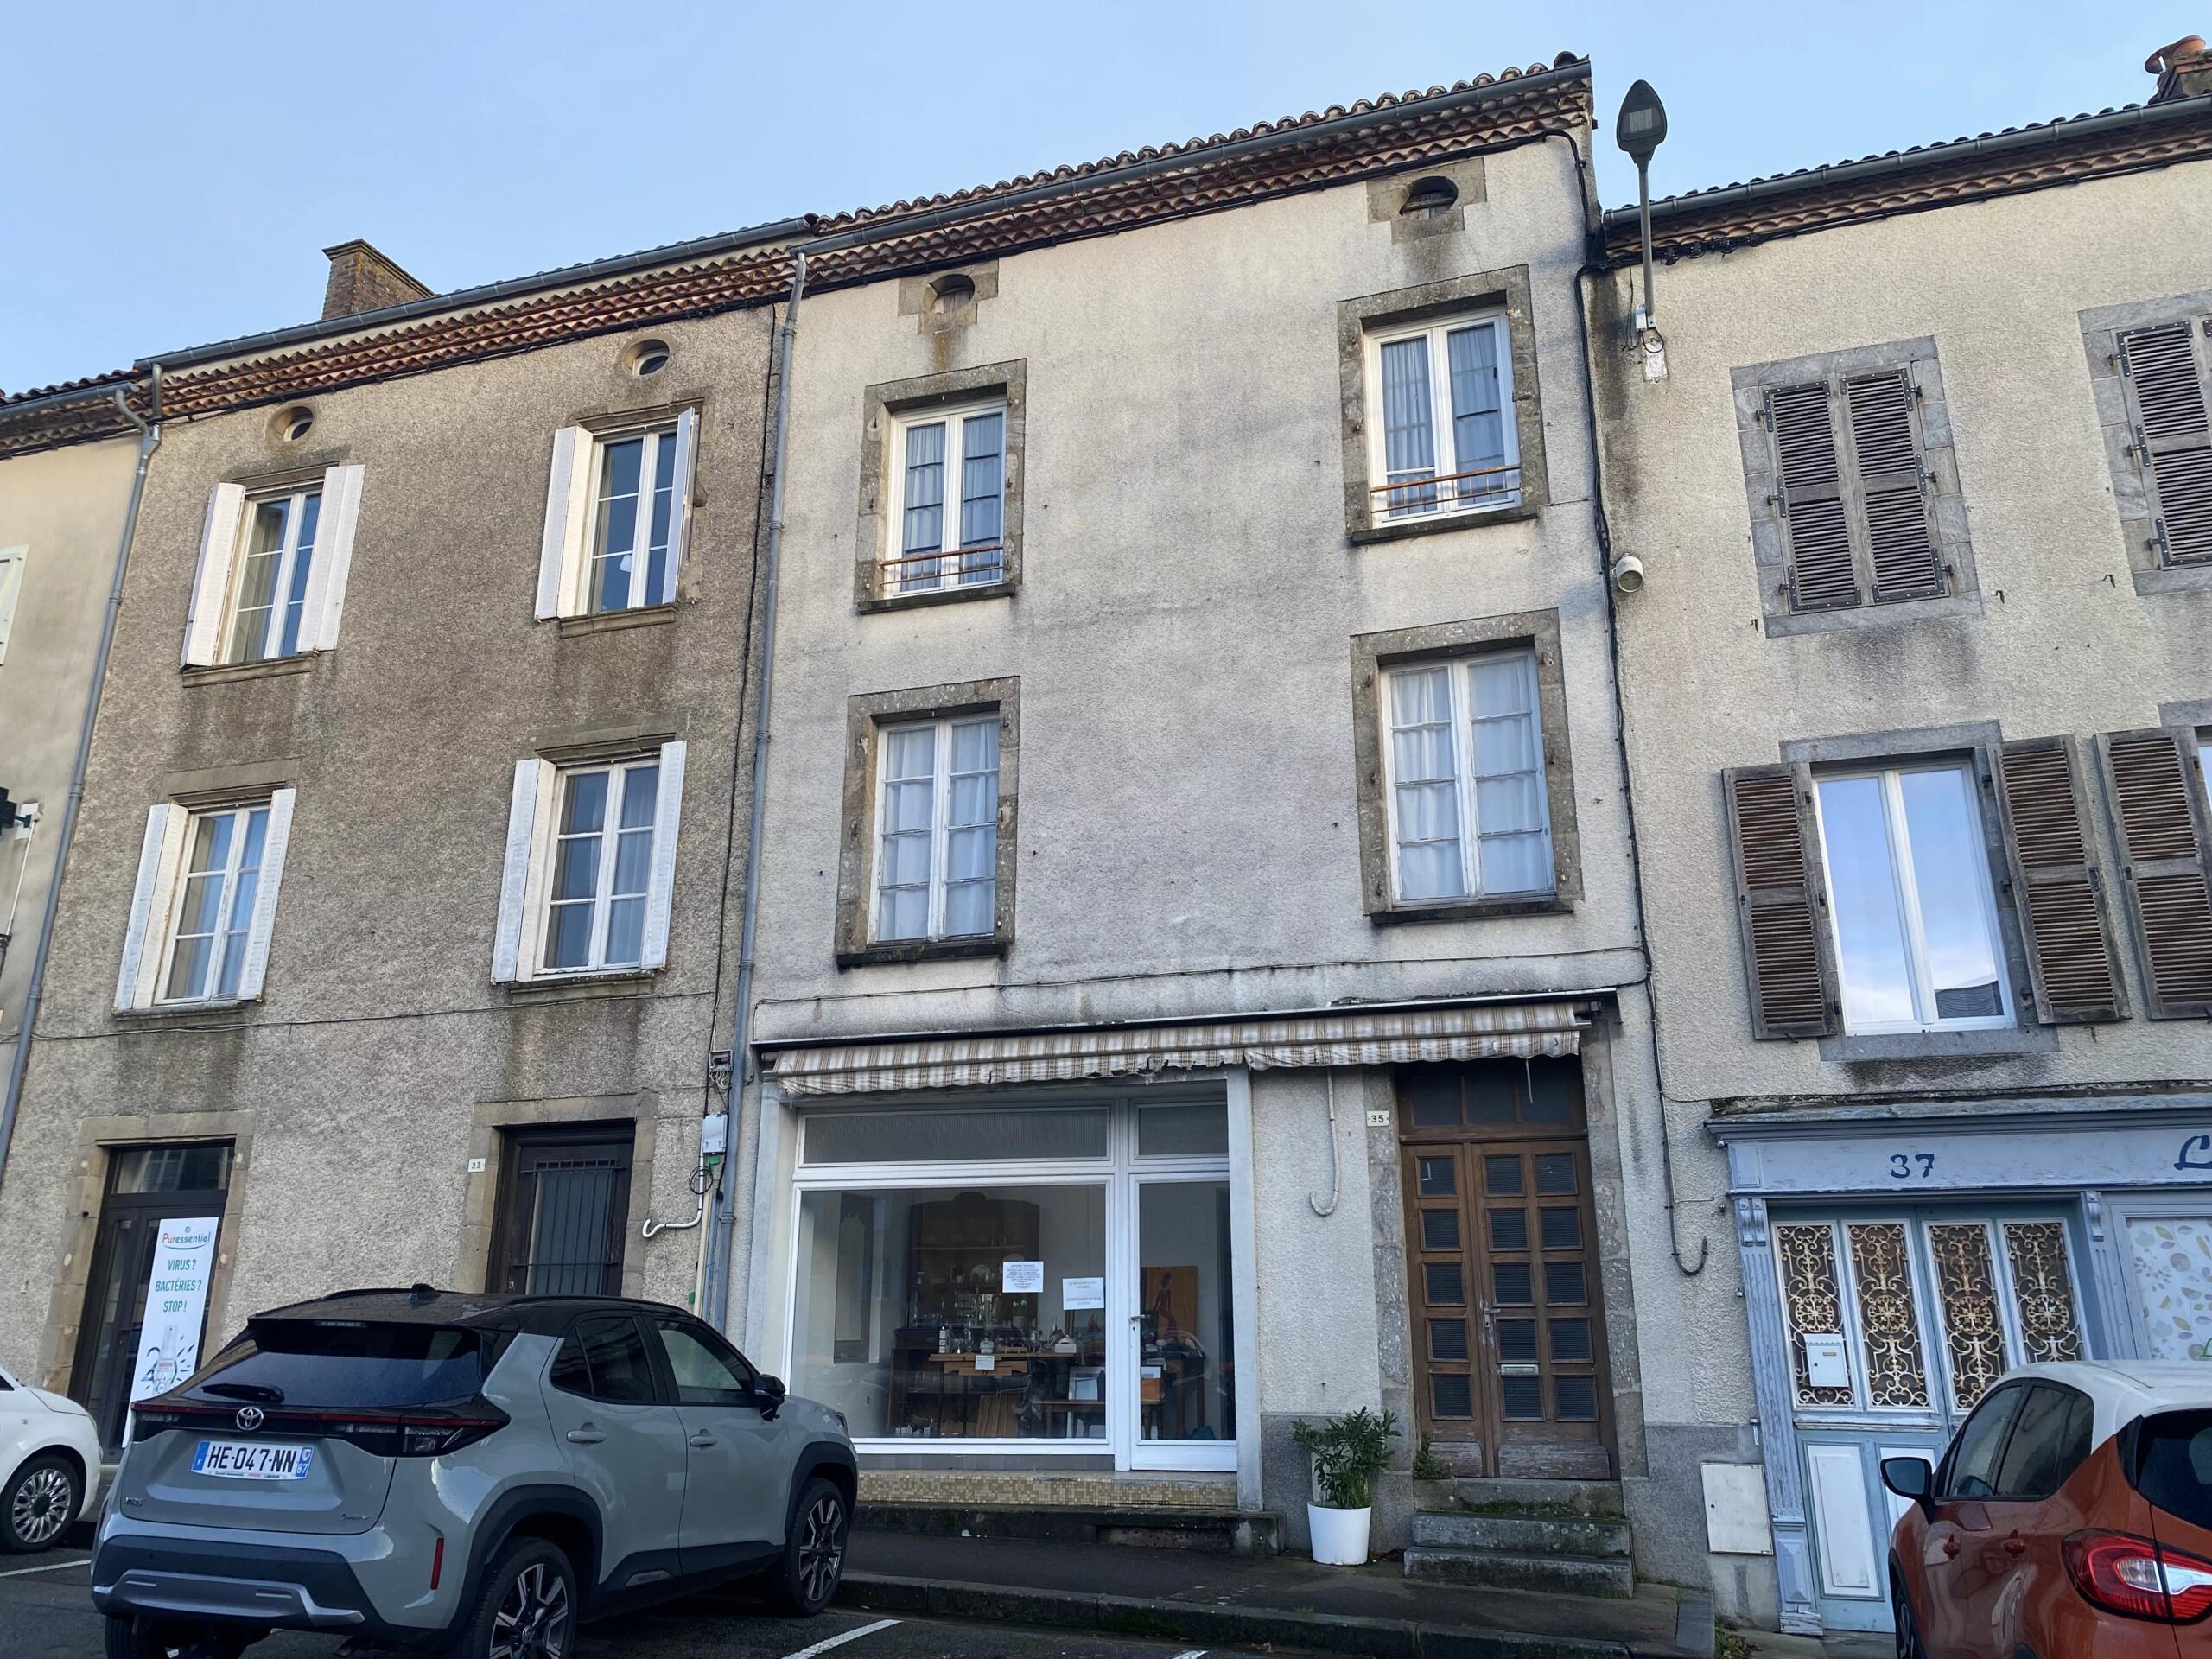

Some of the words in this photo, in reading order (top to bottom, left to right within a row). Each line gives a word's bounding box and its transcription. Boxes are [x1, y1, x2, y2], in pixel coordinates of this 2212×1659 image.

[1371, 1115, 1384, 1123] 35
[1890, 1153, 1936, 1179] 37
[162, 1231, 211, 1244] Puressentiel
[207, 1446, 297, 1473] HE-047-NN
[296, 1463, 308, 1474] 87
